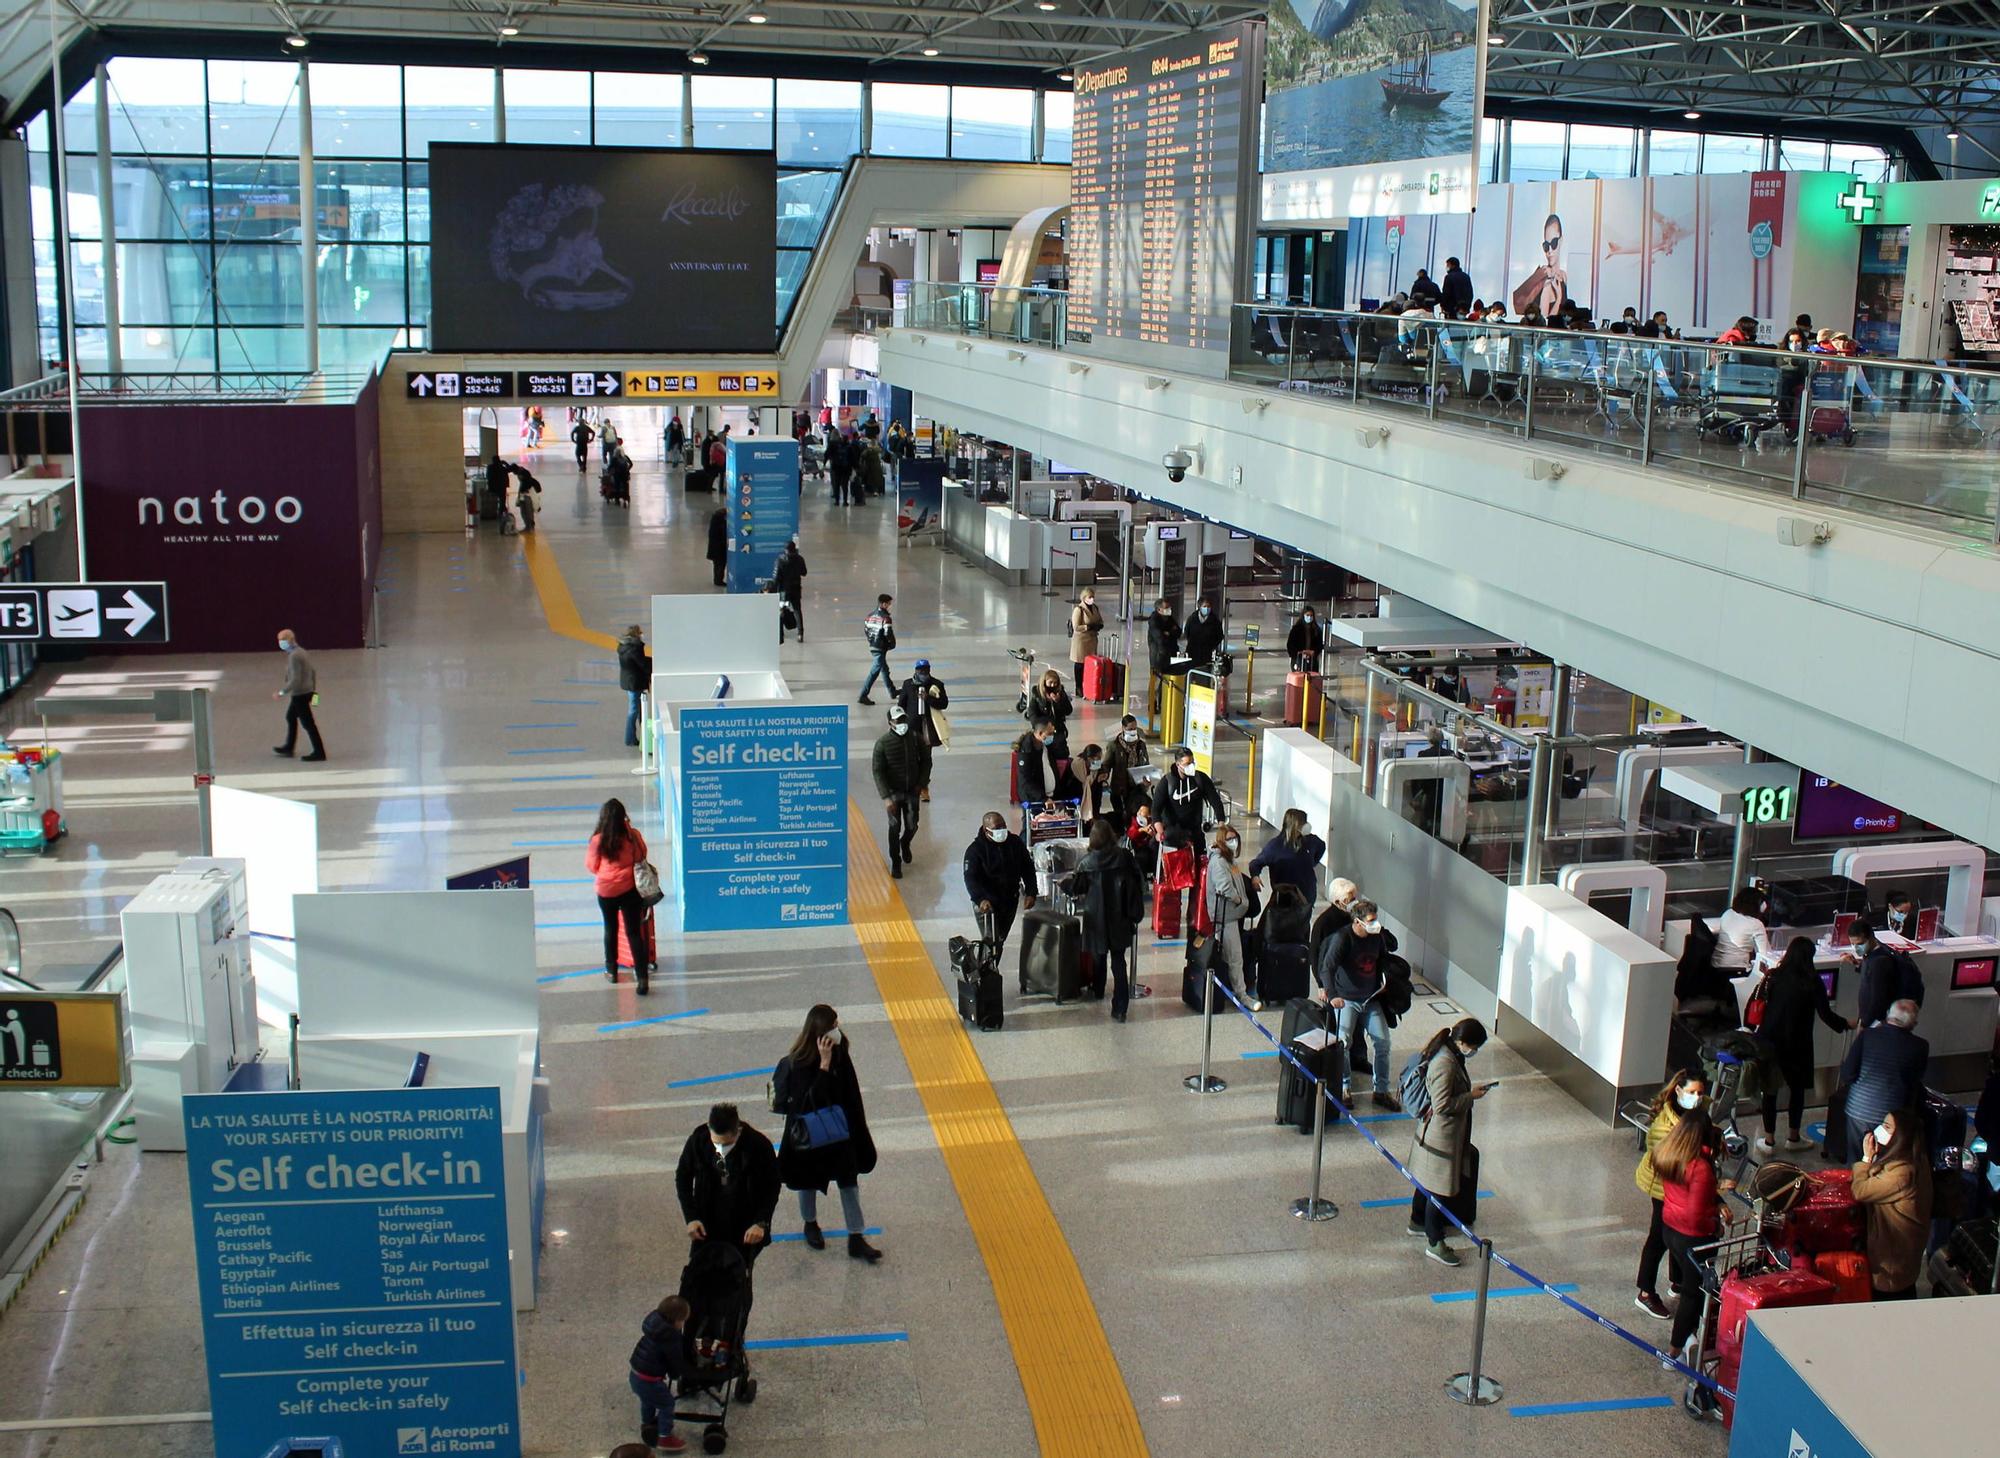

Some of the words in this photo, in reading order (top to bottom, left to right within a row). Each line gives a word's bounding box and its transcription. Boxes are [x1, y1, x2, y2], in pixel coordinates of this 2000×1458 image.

[1085, 66, 1128, 96] Departures
[138, 490, 303, 525] natoo
[0, 602, 34, 628] T3
[715, 719, 746, 727] SALUTE
[768, 718, 800, 726] NOSTRA
[804, 716, 844, 724] PRIORITÀ!
[726, 730, 755, 738] SAFETY
[788, 728, 828, 736] PRIORITY!
[692, 743, 736, 765] Self
[742, 741, 836, 763] check-in
[779, 780, 819, 789] Norwegian
[692, 808, 723, 816] Egyptair
[806, 803, 837, 812] Portugal
[1744, 787, 1791, 823] 181
[1865, 818, 1887, 826] Priority
[702, 842, 741, 851] Effettua
[744, 841, 753, 850] in
[756, 840, 800, 849] sicurezza
[734, 854, 753, 863] Self
[756, 852, 796, 862] check-in
[728, 874, 776, 884] Complete
[778, 874, 800, 883] your
[718, 887, 737, 896] Self
[740, 885, 780, 895] check-in
[782, 884, 811, 895] safely
[799, 903, 842, 912] Aeroporti
[7, 1068, 57, 1078] check-in
[191, 1115, 211, 1129] LA
[214, 1114, 246, 1128] TUA
[251, 1112, 308, 1127] SALUTE
[313, 1110, 321, 1125] È
[326, 1112, 346, 1125] LA
[350, 1110, 413, 1124] NOSTRA
[418, 1105, 493, 1121] PRIORITÀ!
[224, 1132, 268, 1146] YOUR
[272, 1130, 327, 1145] SAFETY
[332, 1129, 346, 1143] IS
[350, 1128, 384, 1142] OUR
[388, 1127, 464, 1140] PRIORITY!
[211, 1154, 292, 1193] Self
[305, 1151, 481, 1188] check-in
[214, 1212, 265, 1224] Aegean
[378, 1205, 444, 1217] Lufthansa
[216, 1225, 272, 1237] Aeroflot
[378, 1219, 453, 1233] Norwegian
[217, 1240, 272, 1252] Brussels
[380, 1233, 416, 1248] Royal
[420, 1233, 439, 1244] Air
[444, 1232, 486, 1244] Maroc
[218, 1254, 265, 1267] Cathay
[268, 1251, 312, 1263] Pacific
[381, 1249, 404, 1260] Sas
[382, 1263, 405, 1275] Tap
[408, 1261, 428, 1272] Air
[432, 1258, 489, 1273] Portugal
[220, 1267, 277, 1282] Egyptair
[382, 1276, 424, 1287] Tarom
[222, 1282, 286, 1296] Ethiopian
[290, 1280, 340, 1292] Airlines
[384, 1290, 432, 1302] Turkish
[436, 1288, 486, 1300] Airlines
[224, 1297, 262, 1309] Iberia
[242, 1324, 315, 1340] Effettua
[320, 1322, 337, 1337] in
[342, 1320, 423, 1336] sicurezza
[428, 1318, 440, 1332] il
[445, 1318, 476, 1332] tuo
[304, 1343, 338, 1360] Self
[343, 1340, 418, 1358] check-in
[296, 1377, 383, 1395] Complete
[388, 1375, 429, 1392] your
[279, 1400, 315, 1416] Self
[319, 1396, 392, 1414] check-in
[398, 1393, 449, 1411] safely
[430, 1423, 509, 1440] Aeroporti
[431, 1441, 446, 1453] di
[449, 1439, 495, 1452] Roma
